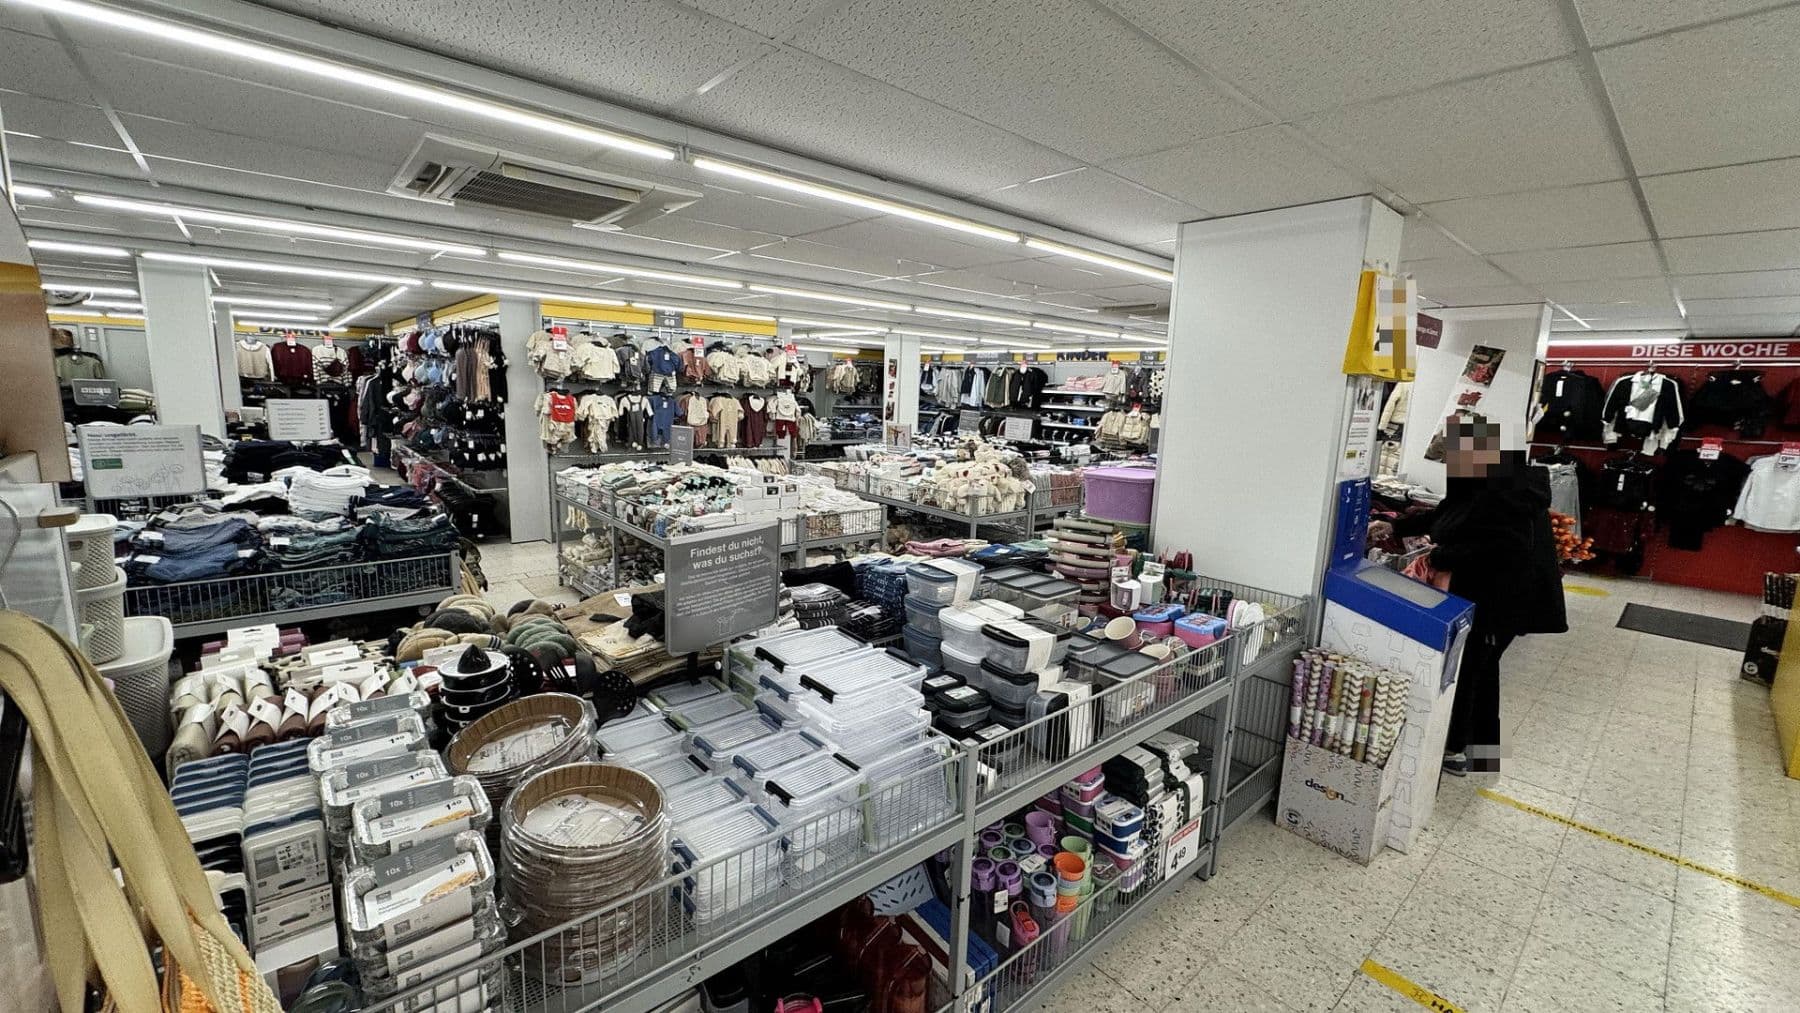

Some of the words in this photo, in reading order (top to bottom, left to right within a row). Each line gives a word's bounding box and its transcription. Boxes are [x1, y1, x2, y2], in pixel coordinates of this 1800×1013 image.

[1056, 351, 1108, 361] KINDER
[1631, 344, 1695, 357] DIESE
[1700, 343, 1789, 357] WOCHE
[690, 543, 726, 558] Findest
[728, 540, 740, 550] du
[741, 535, 765, 548] nicht,
[692, 558, 713, 570] was
[715, 555, 727, 565] du
[729, 546, 762, 562] suchst?
[356, 771, 369, 779] 10x
[389, 799, 404, 808] 10x
[1527, 806, 1577, 827] HALTEN
[1627, 842, 1679, 863] METER
[384, 866, 401, 877] 10x
